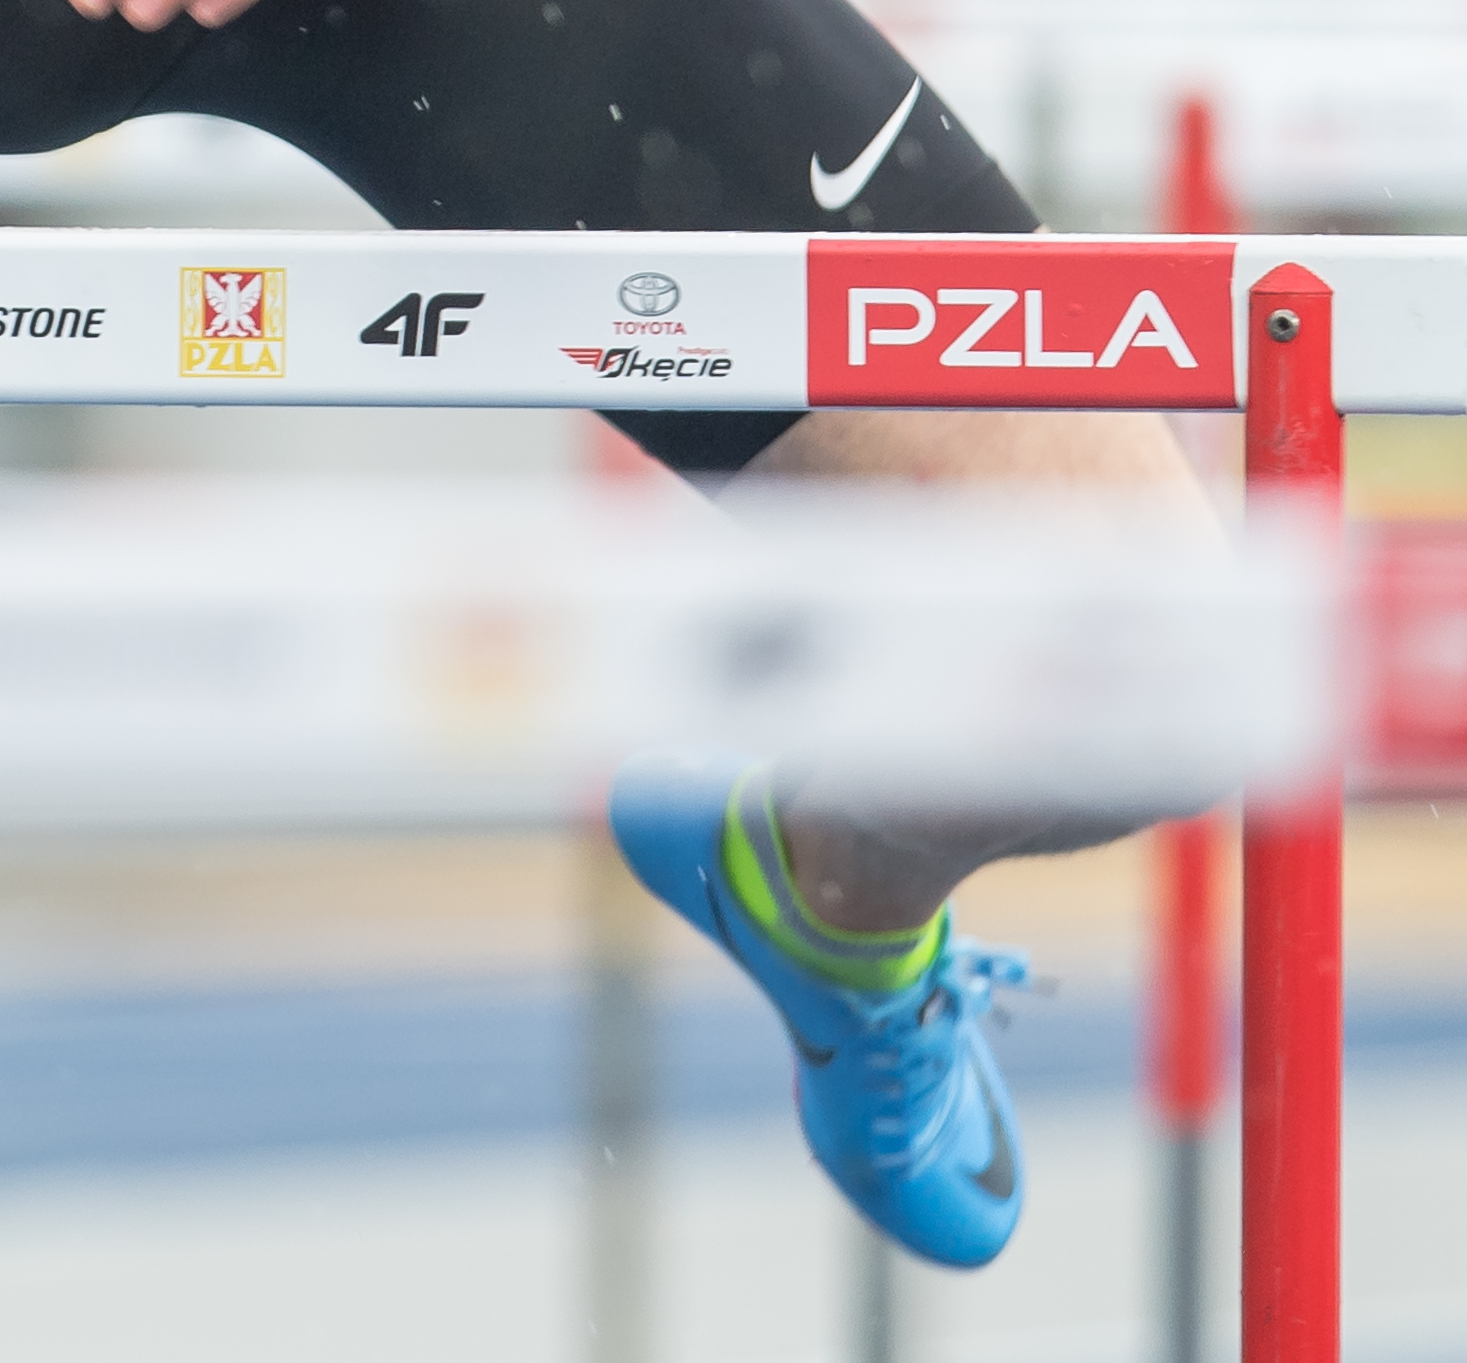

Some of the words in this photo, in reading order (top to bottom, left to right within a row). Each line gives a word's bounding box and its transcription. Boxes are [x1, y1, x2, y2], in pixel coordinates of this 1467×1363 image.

[359, 291, 486, 357] 4F
[612, 321, 687, 335] TOYOTA
[847, 287, 1200, 369] PZLA
[186, 342, 277, 372] PZLA
